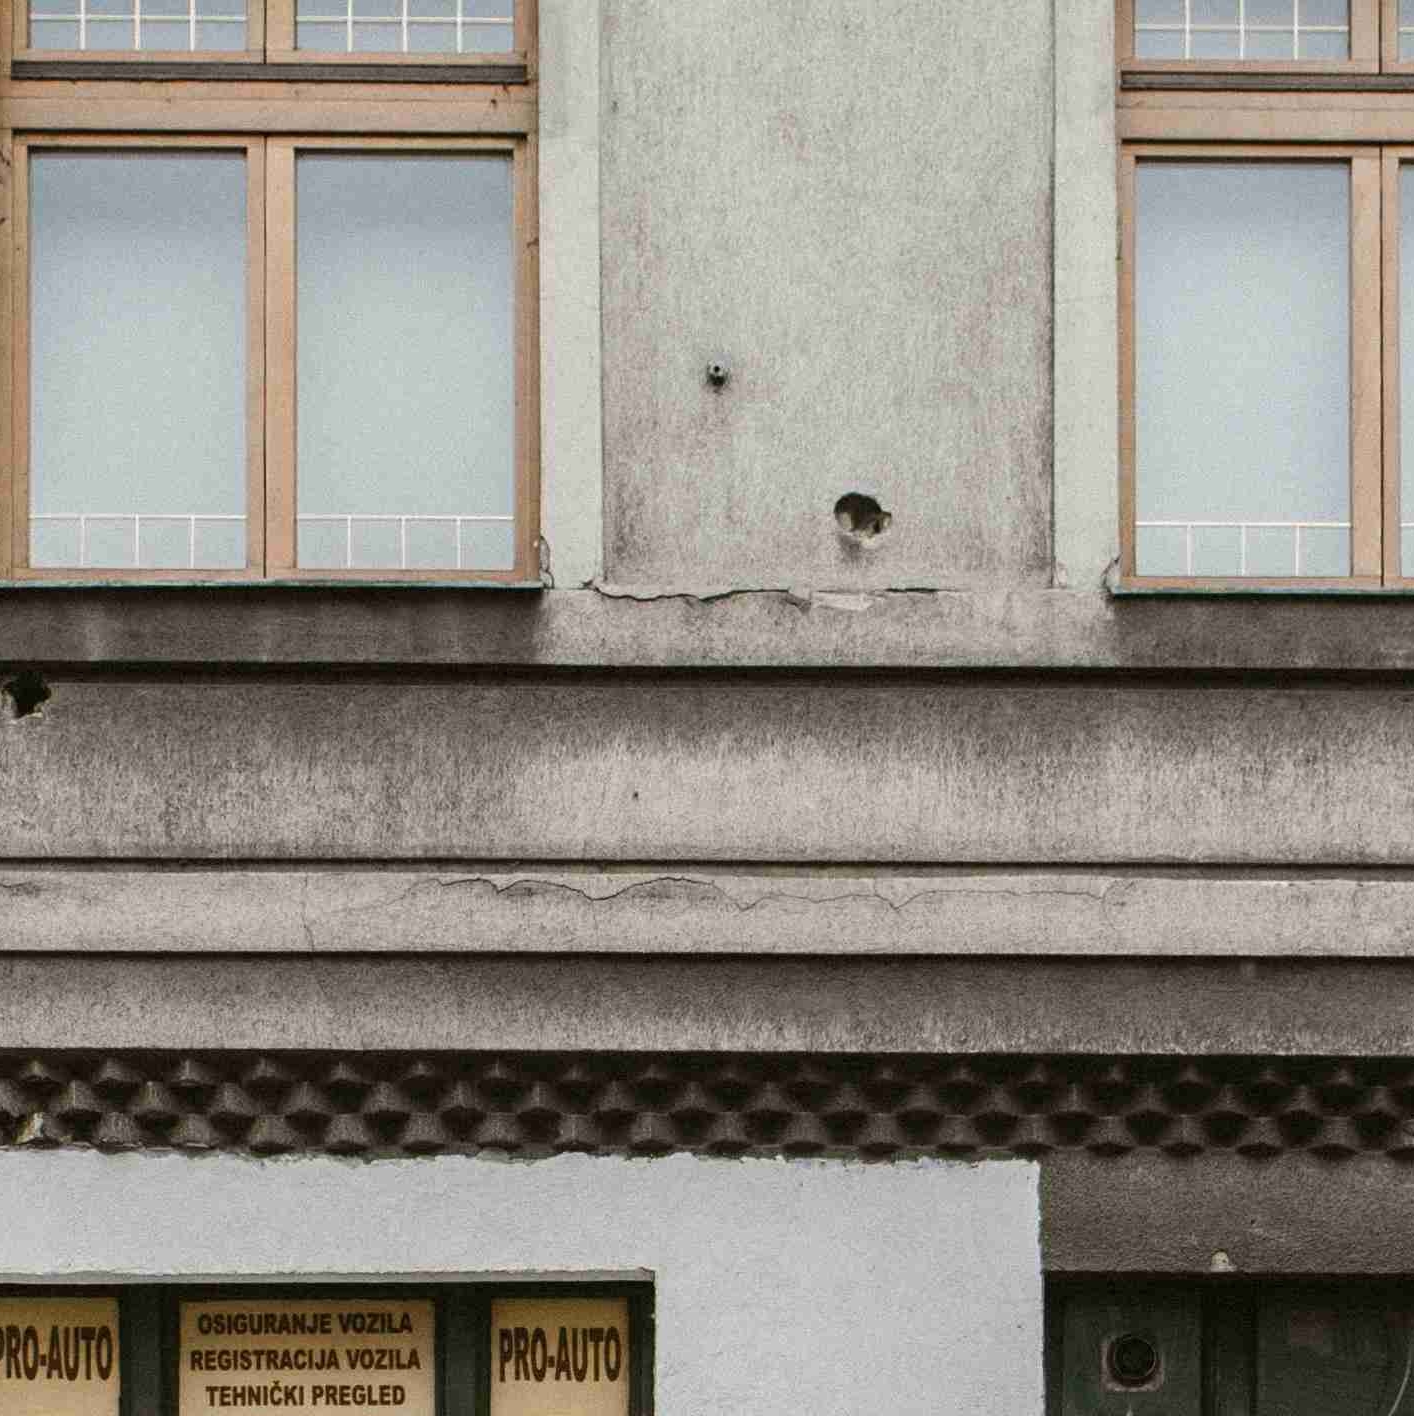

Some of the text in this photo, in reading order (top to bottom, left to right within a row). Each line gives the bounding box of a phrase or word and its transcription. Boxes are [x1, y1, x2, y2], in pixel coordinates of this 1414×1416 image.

[197, 1311, 413, 1335] OSIGURANJE VOZILA
[190, 1348, 421, 1371] REGISTRACIJA VOZILA
[498, 1326, 621, 1383] PRO-AUTO
[205, 1380, 406, 1407] TEHNIČKI PREGLED
